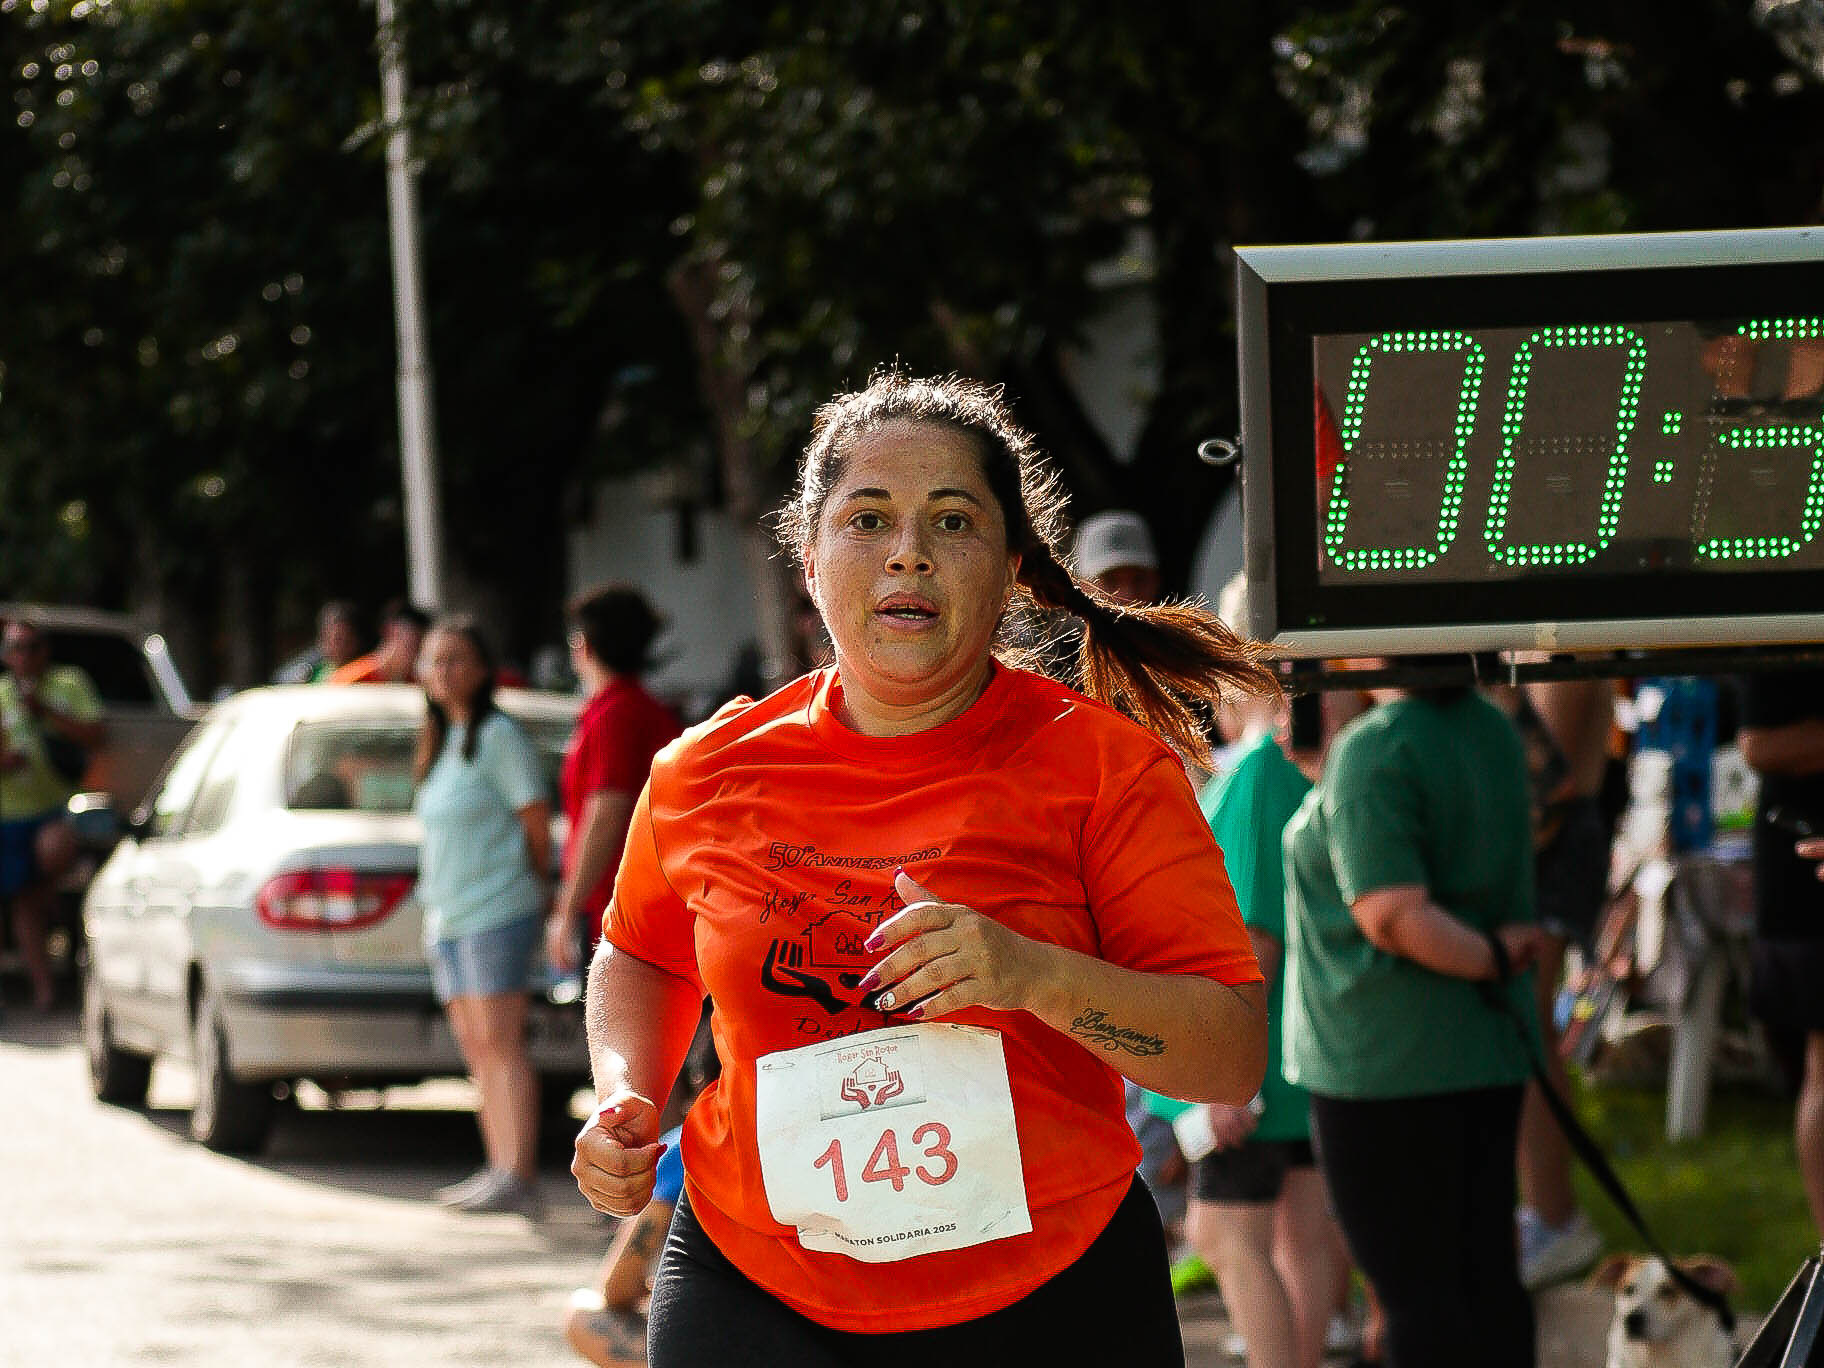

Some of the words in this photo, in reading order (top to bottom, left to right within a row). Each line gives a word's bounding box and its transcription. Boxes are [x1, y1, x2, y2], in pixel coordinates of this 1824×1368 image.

[826, 880, 872, 906] San
[814, 1122, 958, 1202] 143
[876, 1227, 931, 1245] SOLIDARIA
[932, 1223, 957, 1234] 2025
